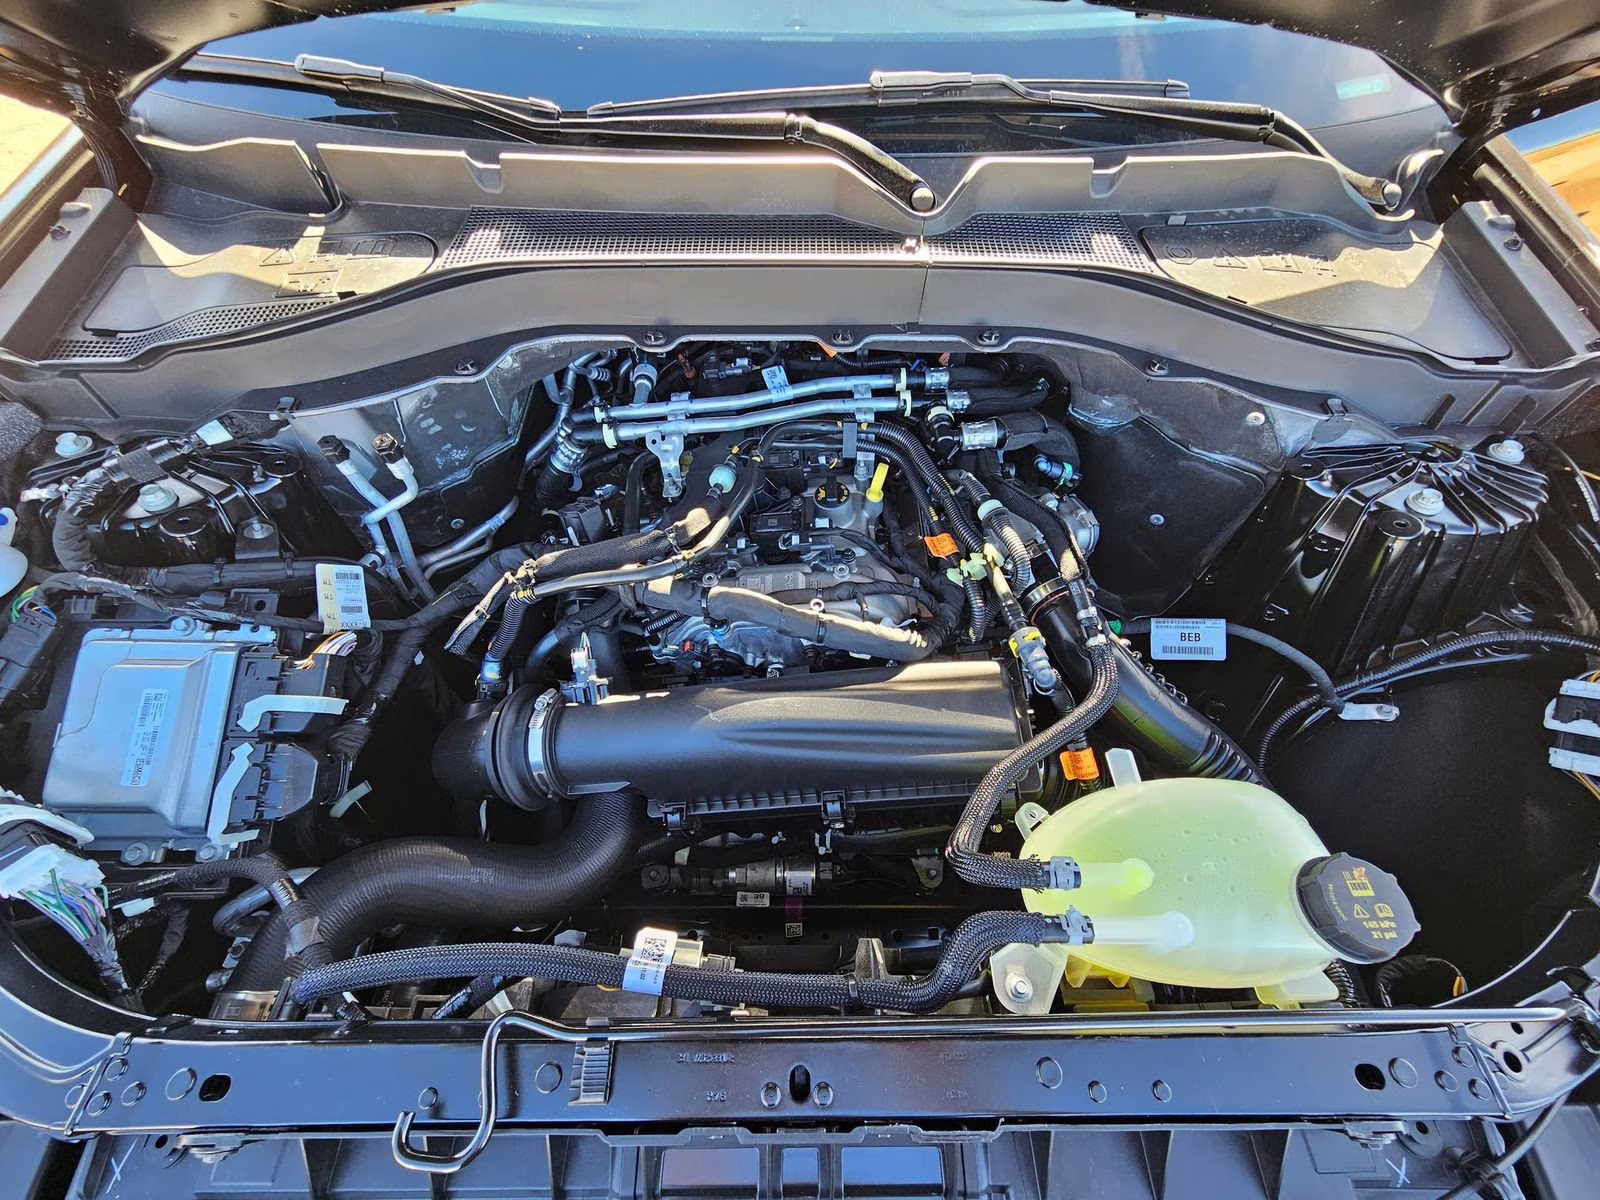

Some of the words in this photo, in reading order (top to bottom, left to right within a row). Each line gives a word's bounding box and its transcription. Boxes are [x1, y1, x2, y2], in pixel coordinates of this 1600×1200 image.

[1181, 632, 1201, 642] BEB
[1379, 920, 1397, 928] kPa
[1371, 931, 1383, 939] 21
[1384, 930, 1398, 940] psi
